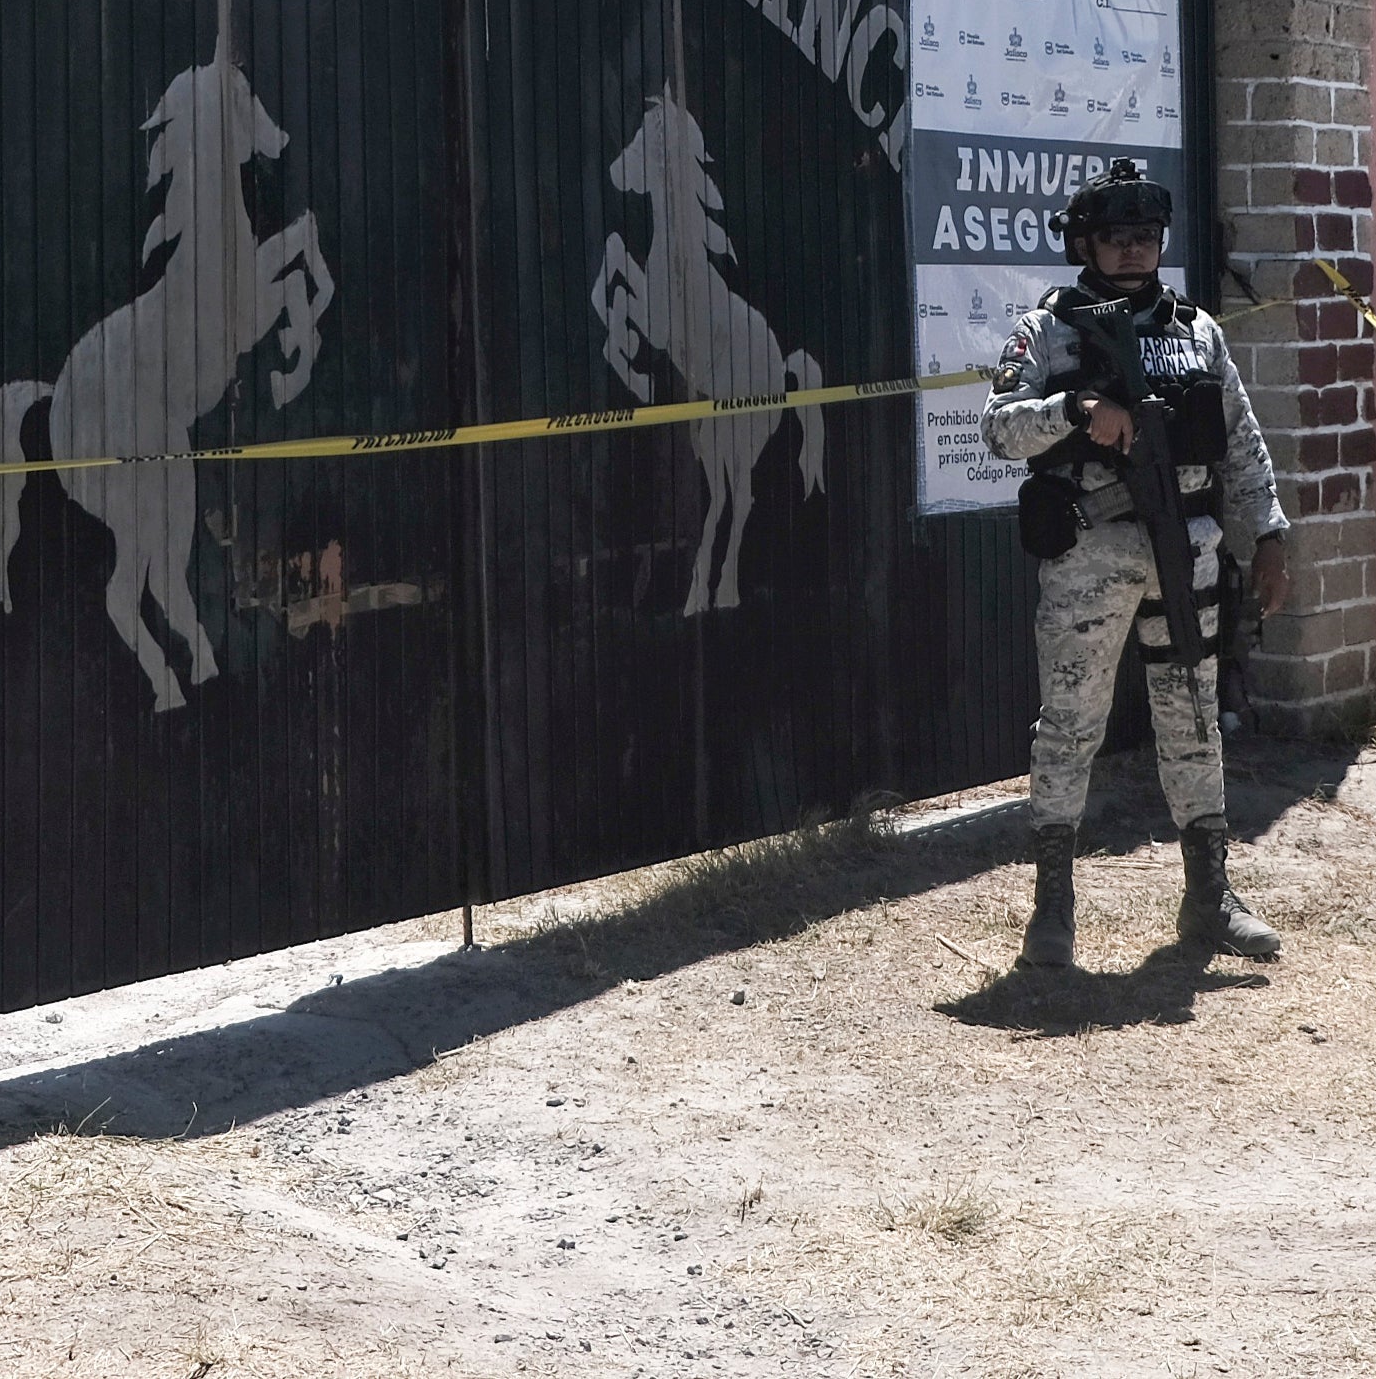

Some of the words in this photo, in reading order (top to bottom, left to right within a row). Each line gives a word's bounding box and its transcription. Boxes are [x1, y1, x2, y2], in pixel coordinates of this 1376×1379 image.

[957, 147, 1147, 196] INMUE
[1139, 337, 1184, 356] ARDIA
[927, 410, 979, 428] Prohibido
[937, 434, 951, 446] en
[954, 432, 979, 445] caso
[938, 448, 976, 469] prisión
[978, 451, 985, 466] y
[967, 464, 1003, 483] Código
[1005, 464, 1033, 478] Pena
